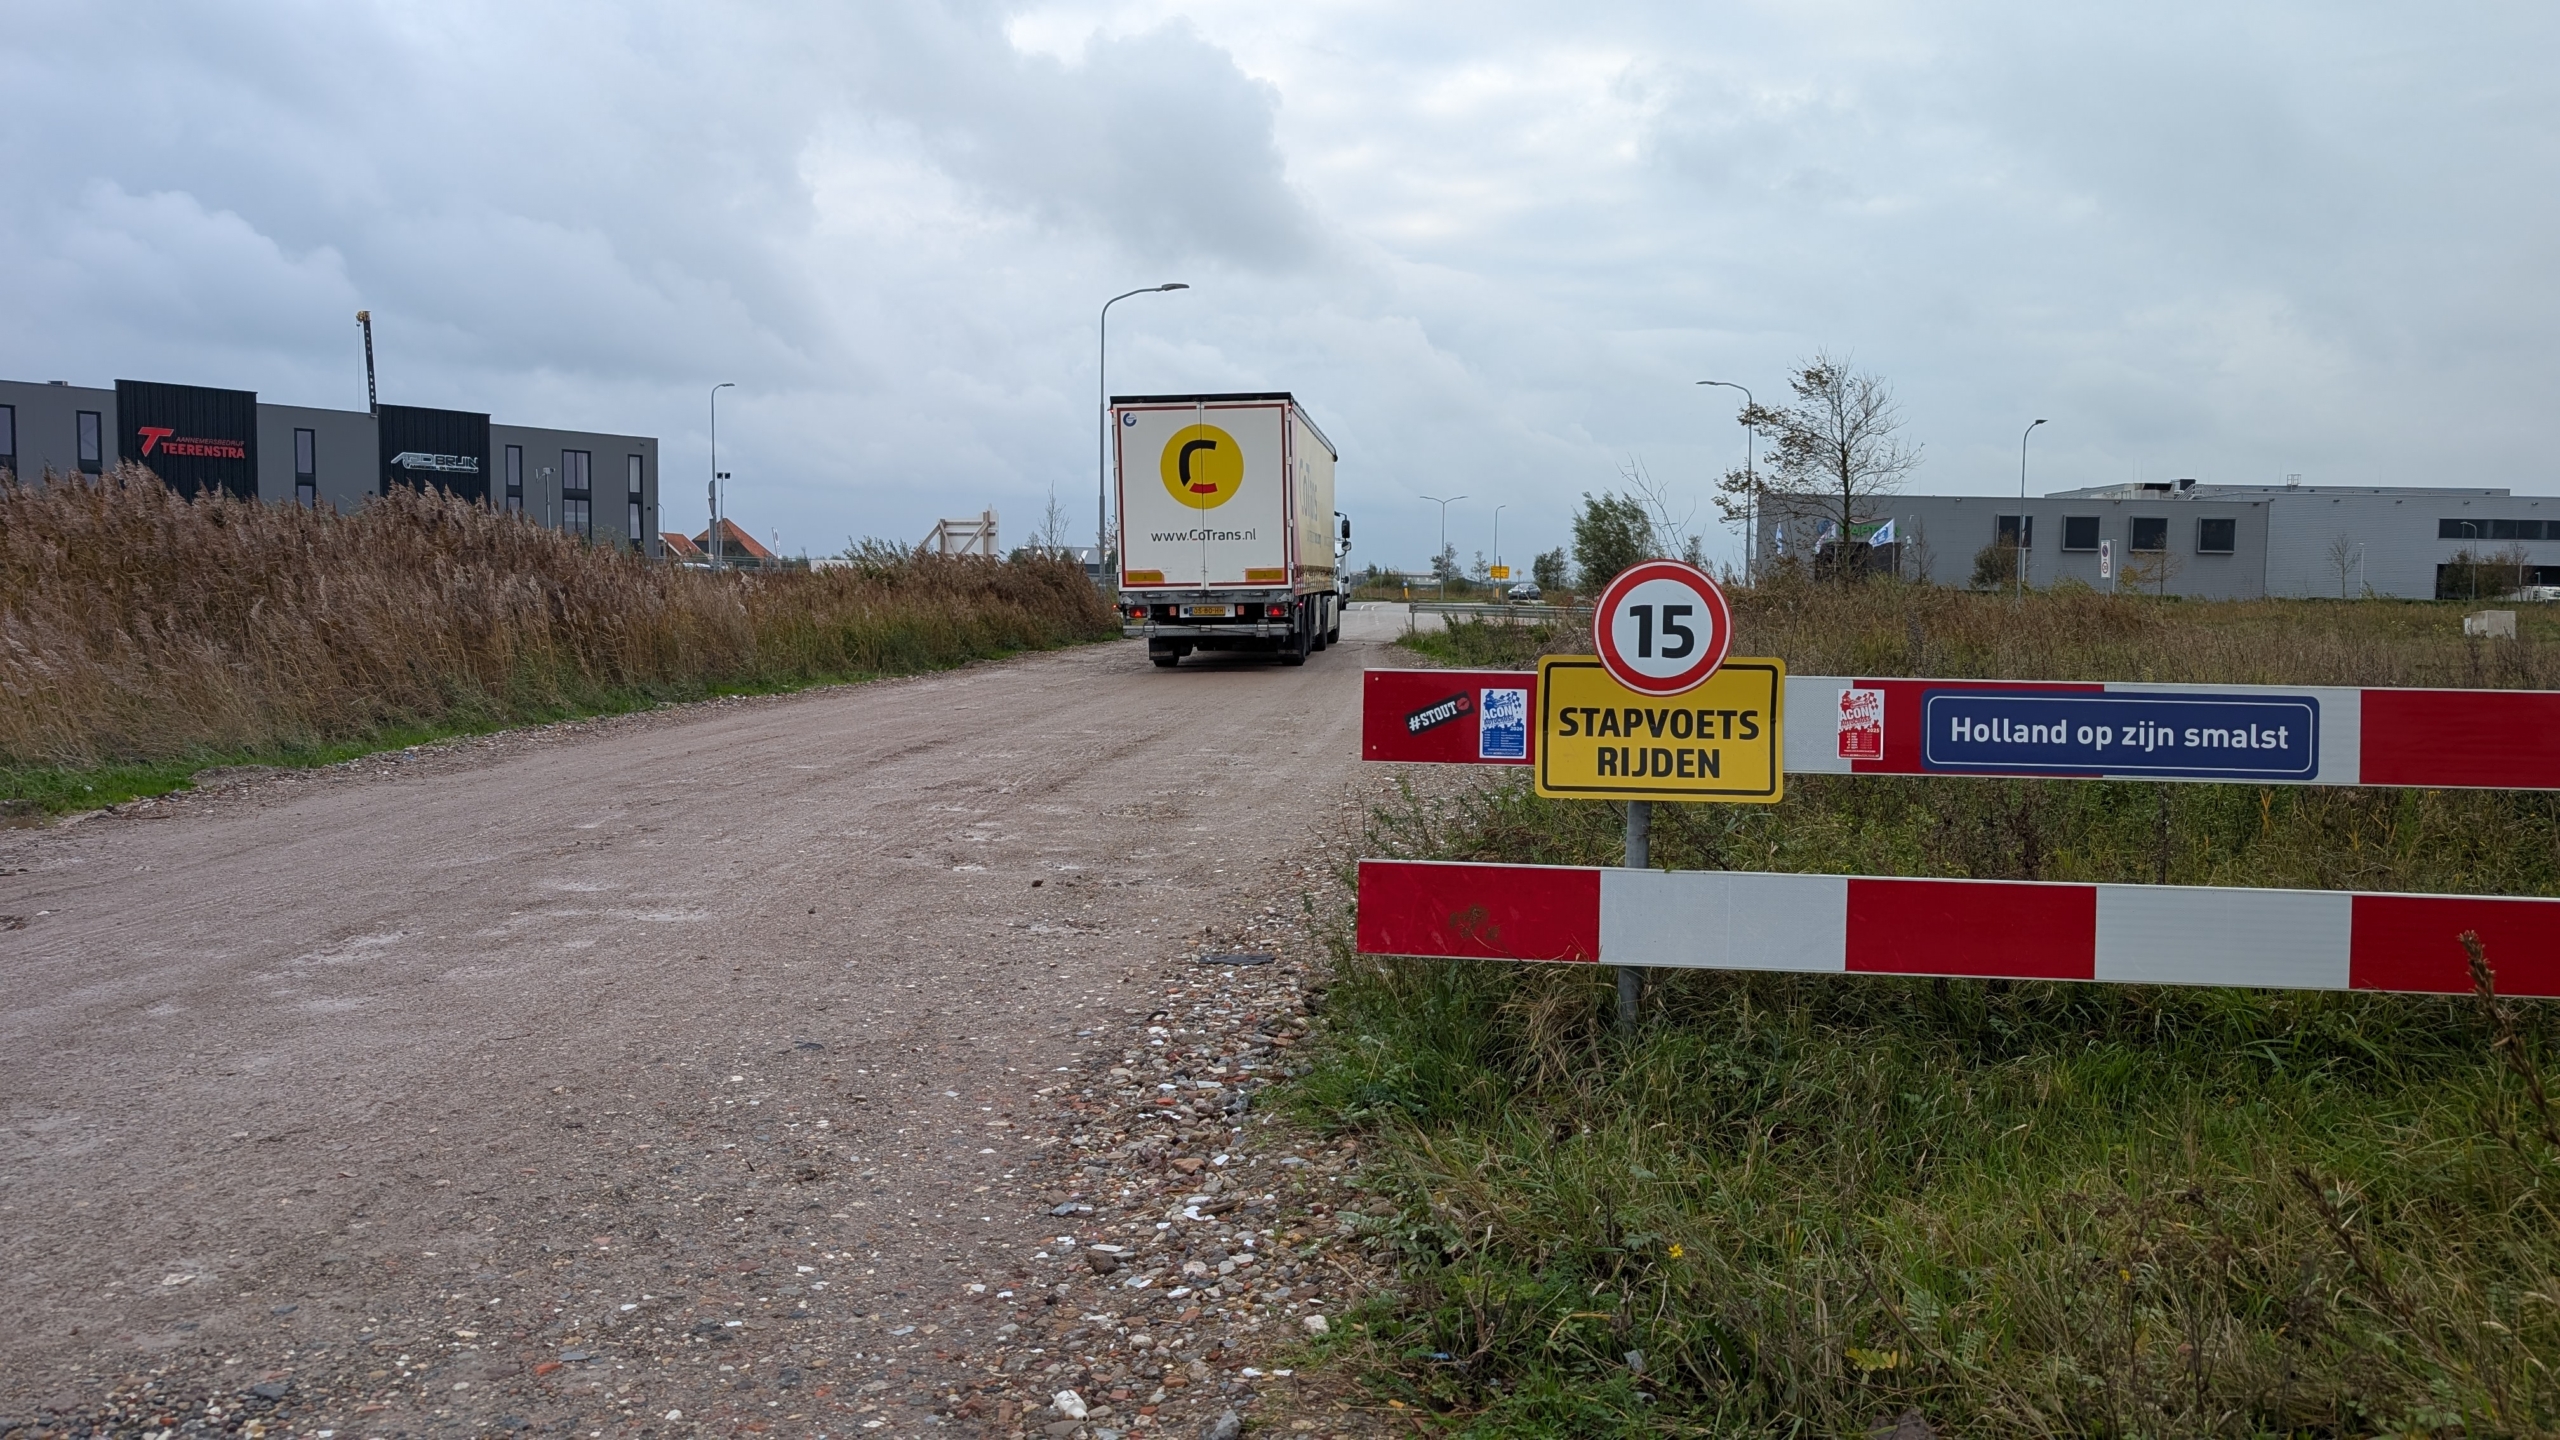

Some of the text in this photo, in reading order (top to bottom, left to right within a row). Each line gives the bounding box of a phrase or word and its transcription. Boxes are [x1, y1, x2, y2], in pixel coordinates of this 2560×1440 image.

[161, 442, 245, 459] TEERENSTRA
[176, 436, 244, 447] AANNEMERSBEDRIJF
[1151, 528, 1256, 542] www.CoTrans.nl
[1629, 604, 1695, 659] 15
[1408, 700, 1457, 731] #STOUT
[1484, 705, 1513, 720] ACON
[1558, 706, 1760, 740] STAPVOETS
[1840, 706, 1870, 721] ACON
[1951, 717, 2289, 752] Holland op zijn smalst
[1597, 746, 1720, 779] RIJDEN
